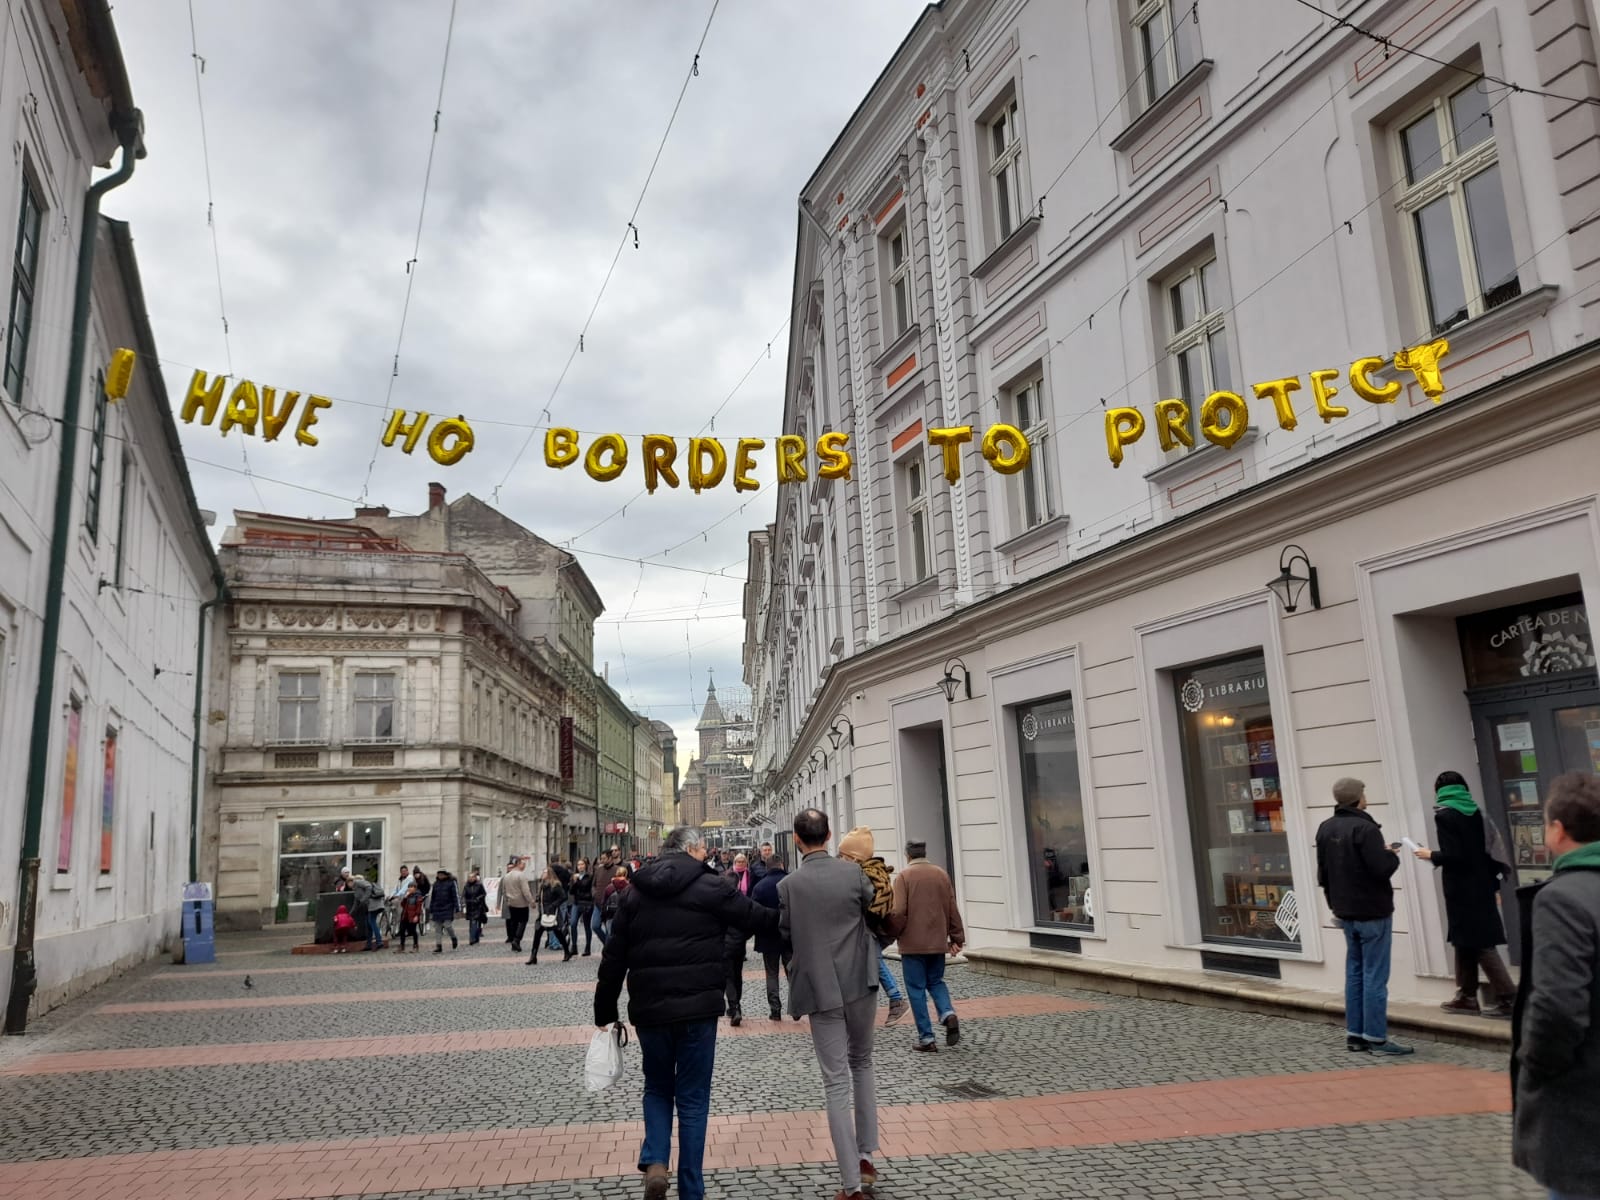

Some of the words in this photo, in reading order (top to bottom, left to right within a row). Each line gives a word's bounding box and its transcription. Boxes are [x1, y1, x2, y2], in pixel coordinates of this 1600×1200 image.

[104, 347, 136, 403] I
[180, 368, 333, 447] HAVE
[543, 427, 851, 494] BORDERS
[928, 423, 1031, 486] TO
[1104, 338, 1450, 468] PROTECT
[1490, 616, 1546, 648] CARTEA
[1548, 610, 1570, 626] DE
